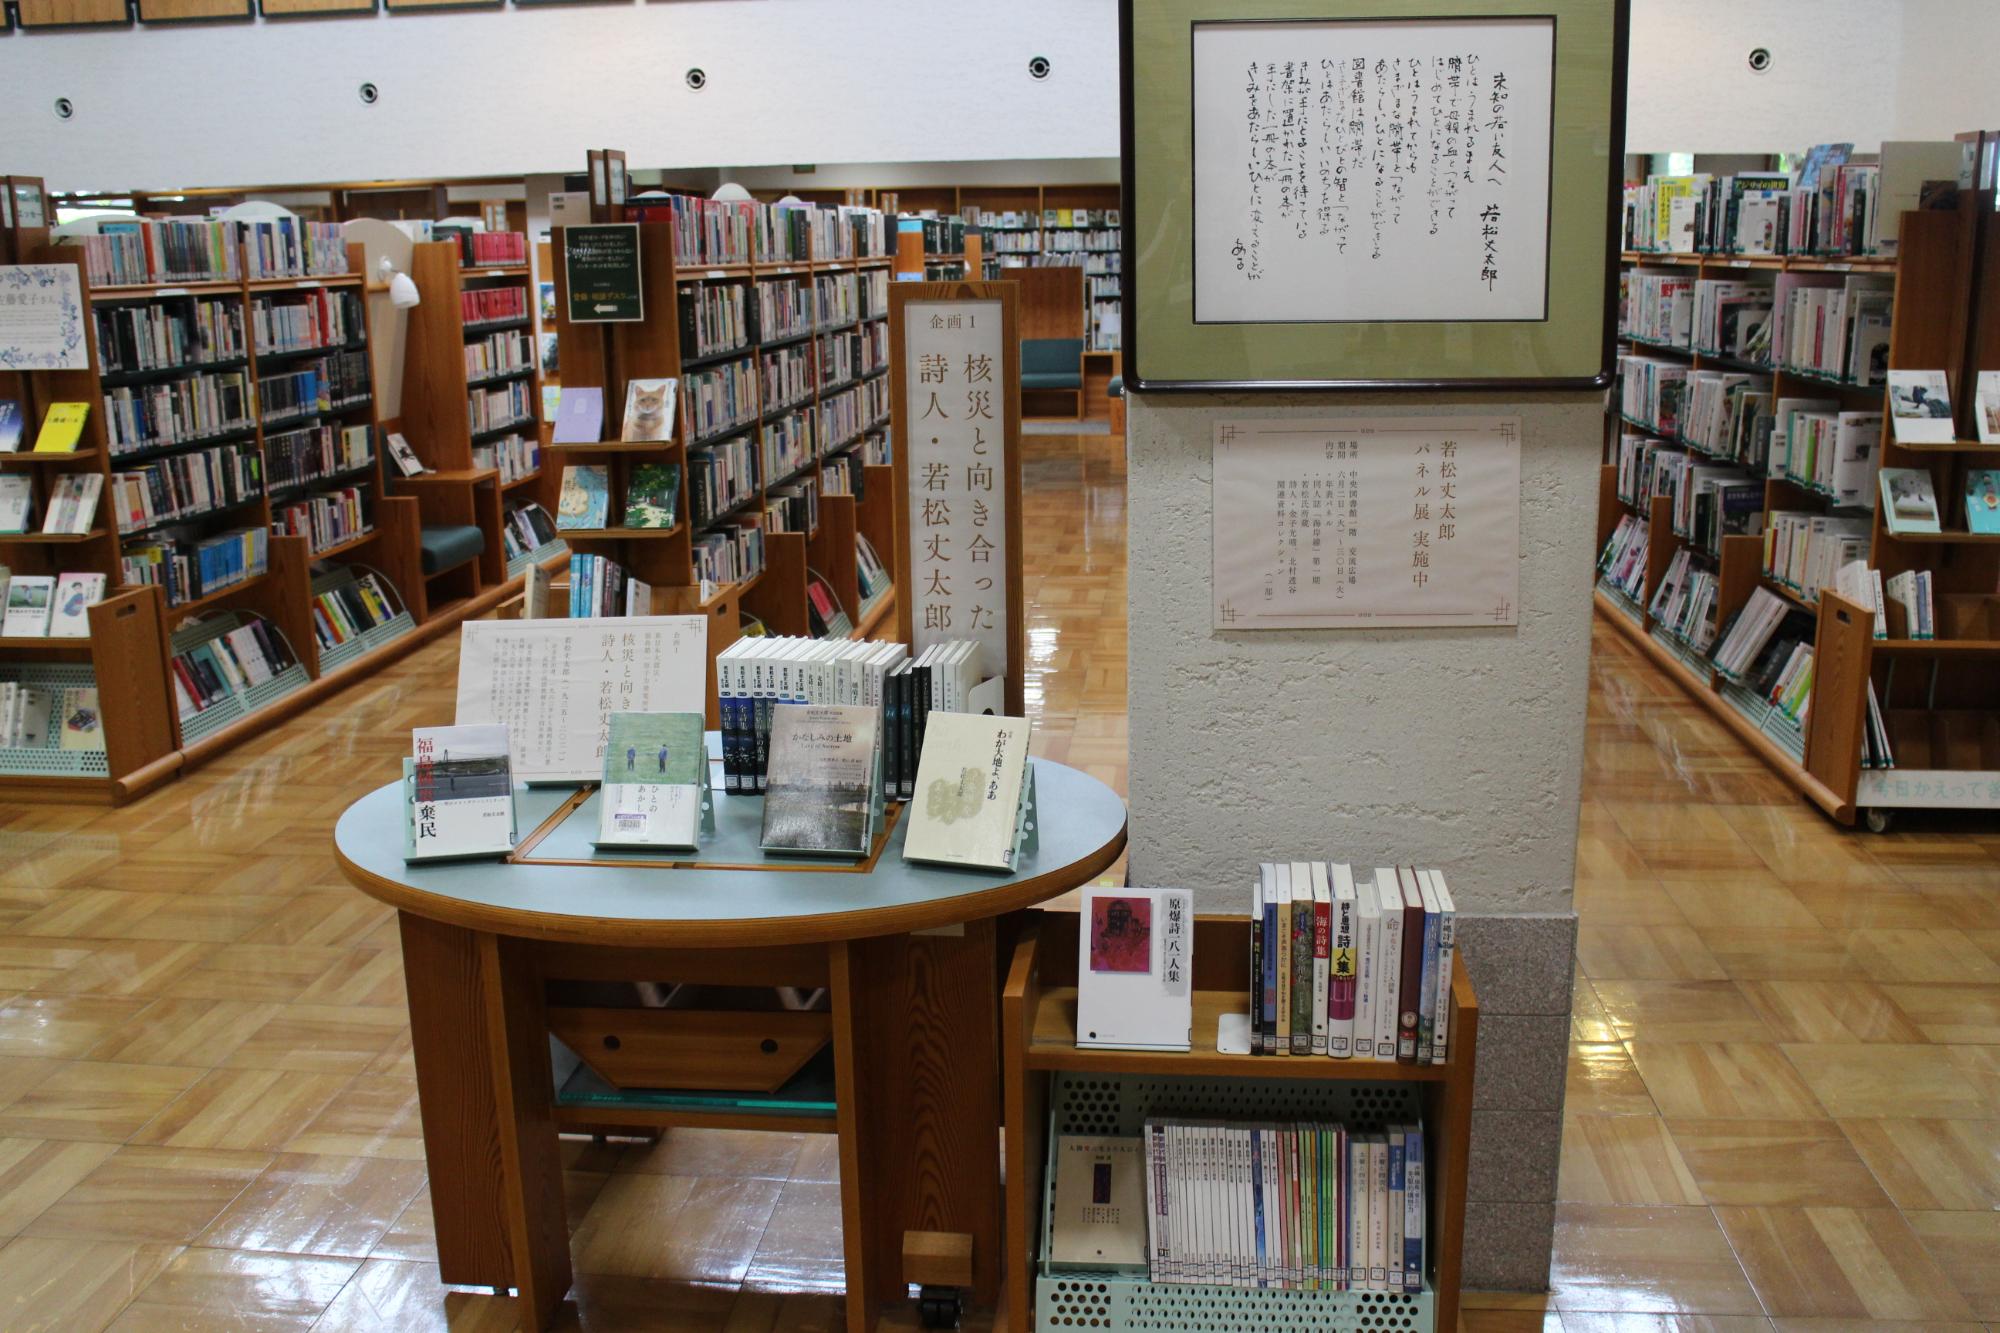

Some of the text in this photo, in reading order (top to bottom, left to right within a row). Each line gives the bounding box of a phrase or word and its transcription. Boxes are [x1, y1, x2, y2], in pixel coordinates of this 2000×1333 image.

[1405, 58, 1421, 174] ひとはうまれてからも
[1464, 54, 1480, 183] ひとはうまれるまえ
[1480, 72, 1508, 292] 未知の若い友人へ 若松丈太郎
[919, 354, 952, 631] 詩人・若松丈太郎
[963, 354, 995, 630] 核災と向き合った
[1438, 440, 1457, 541] 若松丈太郎
[792, 732, 852, 743] かなしみの土地
[987, 729, 1007, 800] わが大地よ、ああ
[648, 785, 659, 813] ひとの
[1169, 898, 1181, 983] 原爆詩一八一人集
[1316, 916, 1327, 957] 海の詩集
[1336, 935, 1351, 974] 詩人集
